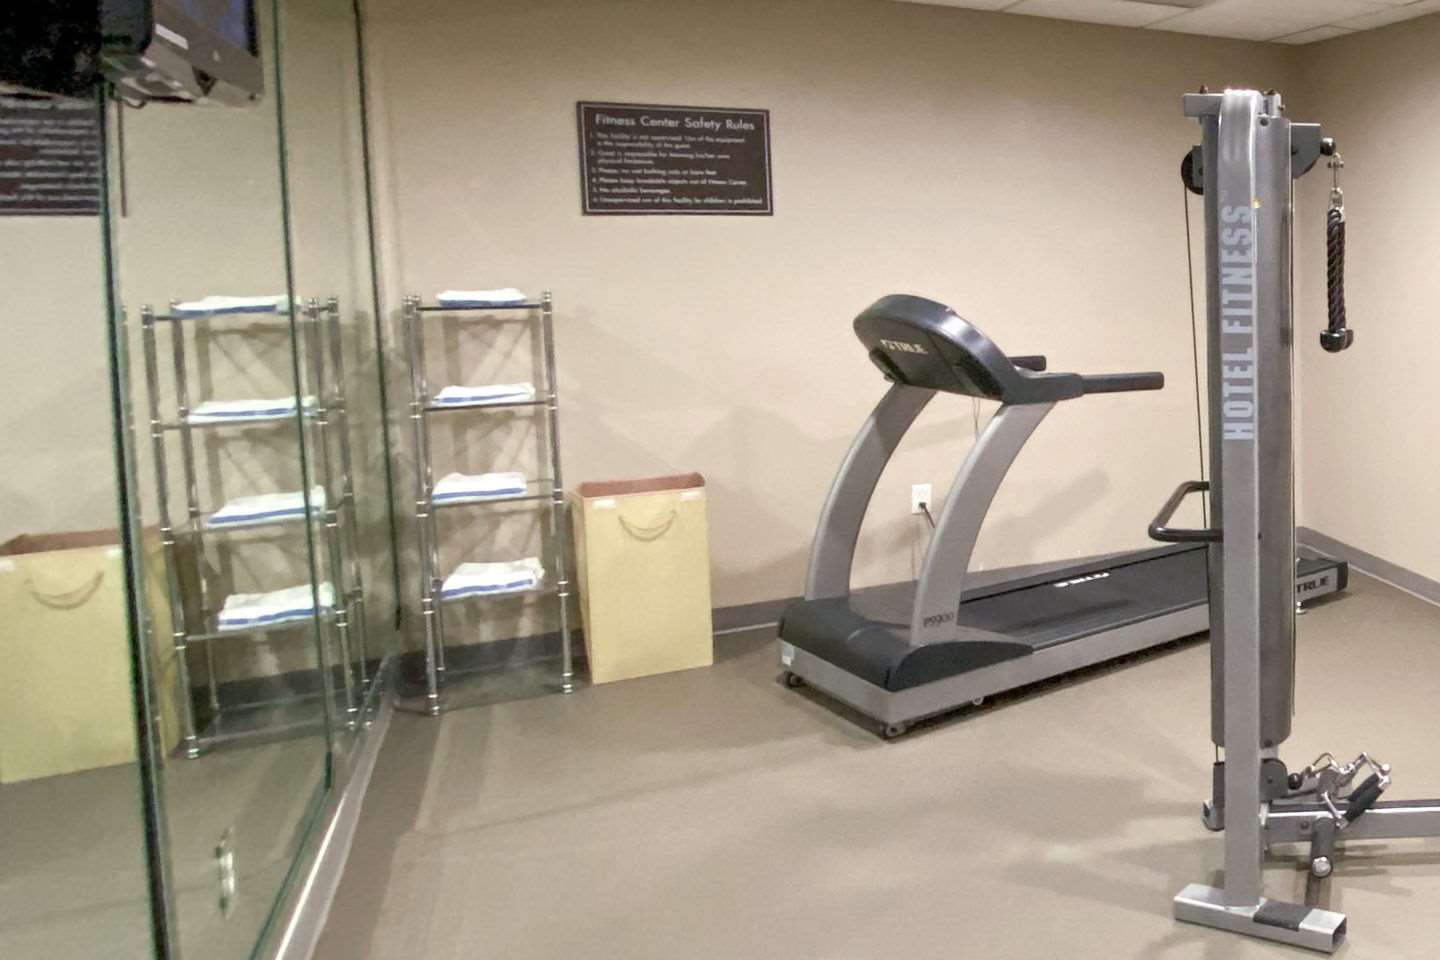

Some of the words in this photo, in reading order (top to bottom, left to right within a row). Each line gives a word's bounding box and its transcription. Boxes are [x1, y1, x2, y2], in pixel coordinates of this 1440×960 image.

[595, 113, 637, 126] Fitness
[640, 115, 681, 128] Center
[684, 116, 722, 132] Safety
[725, 119, 756, 131] Rules
[1221, 205, 1254, 335] FITNESS
[1222, 346, 1255, 441] HOTEL
[1296, 576, 1330, 595] TRUE
